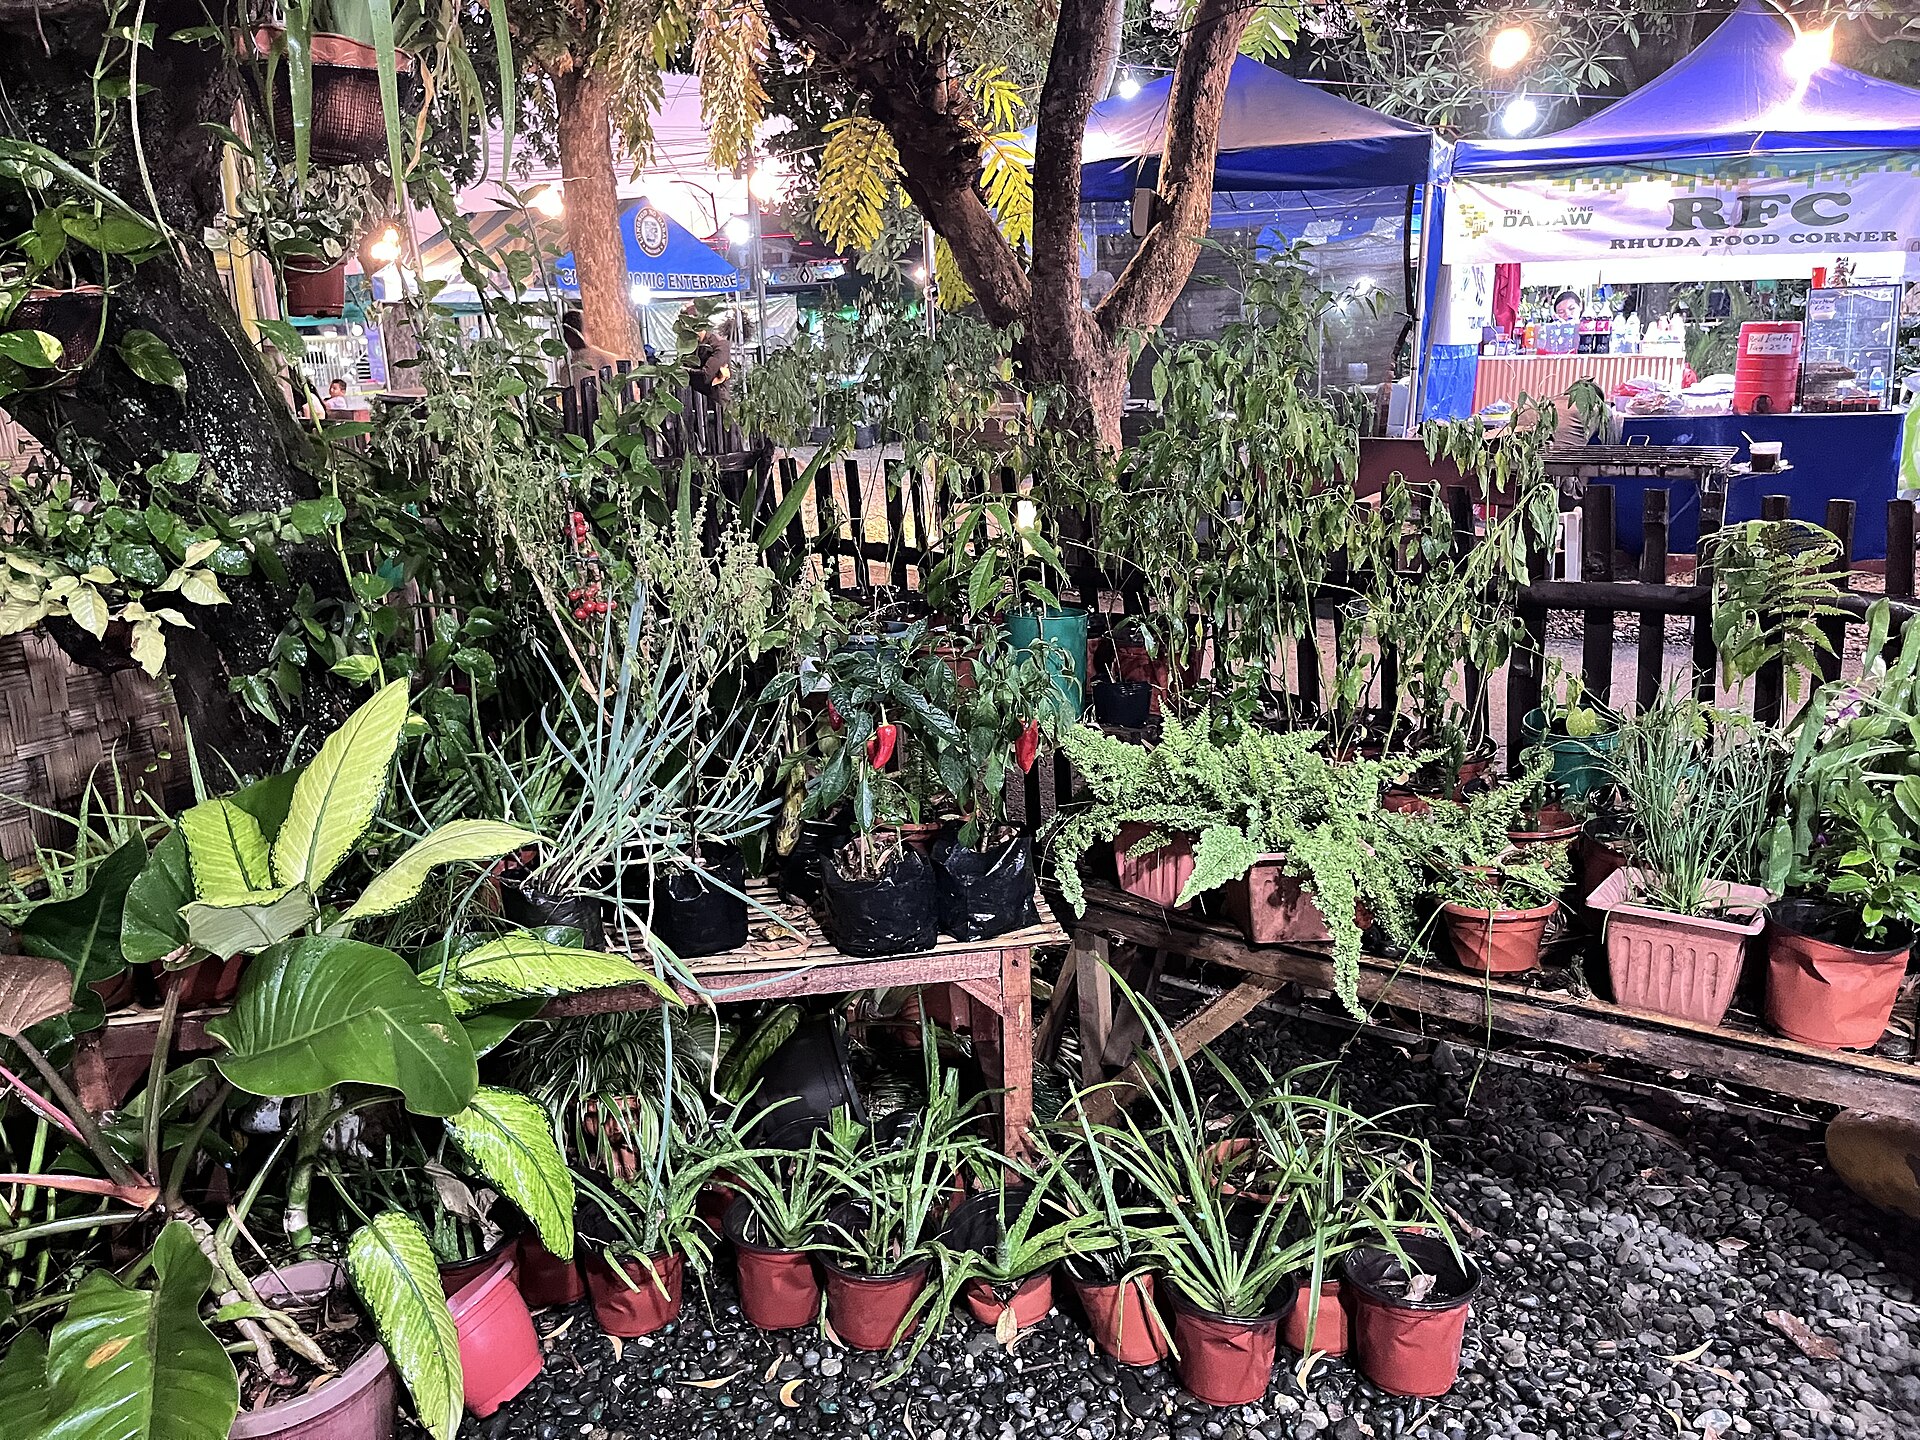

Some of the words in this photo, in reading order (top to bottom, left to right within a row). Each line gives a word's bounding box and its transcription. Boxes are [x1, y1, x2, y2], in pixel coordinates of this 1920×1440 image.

[1666, 191, 1852, 231] RFC
[1609, 236, 1701, 249] RHUDA
[1709, 234, 1780, 246] FOOD
[1788, 231, 1898, 243] CORNER
